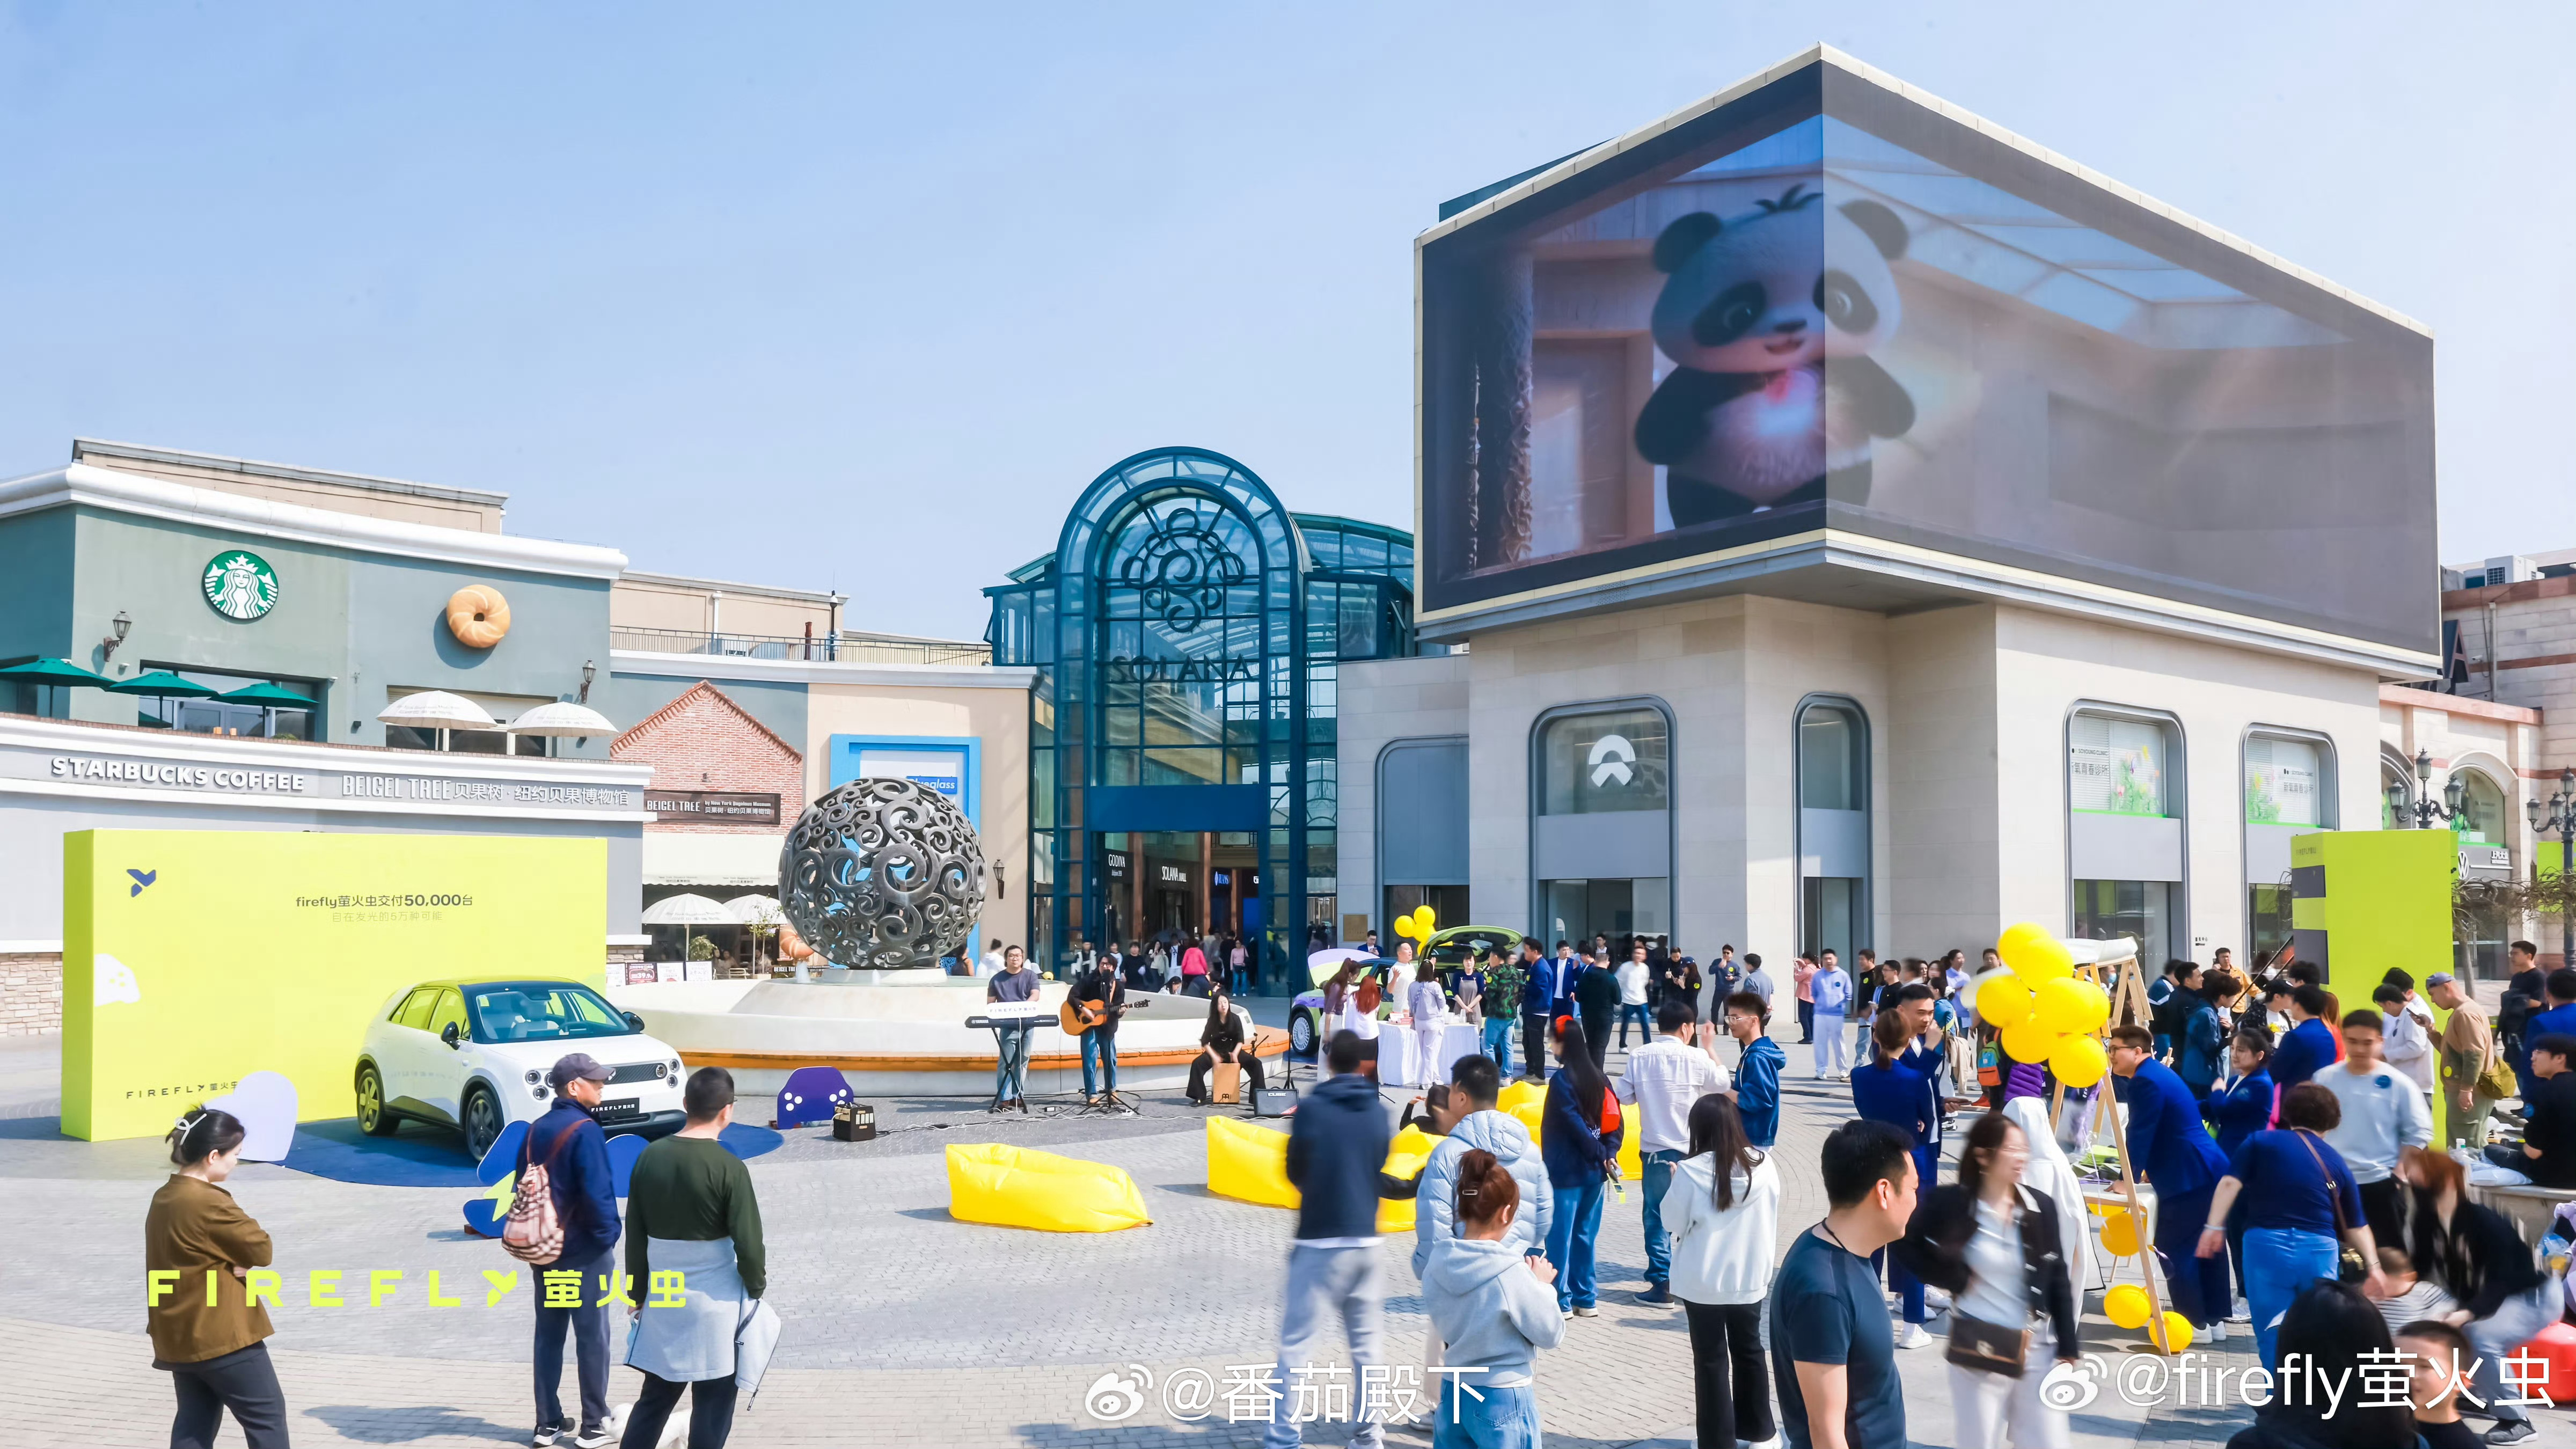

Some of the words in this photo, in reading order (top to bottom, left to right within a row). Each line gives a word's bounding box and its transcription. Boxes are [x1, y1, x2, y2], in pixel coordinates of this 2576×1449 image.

[1110, 653, 1255, 684] SOLANA
[52, 757, 208, 785] STARBUCKS
[214, 770, 304, 791] COFFEE
[342, 774, 402, 799] BEIGEL
[408, 778, 452, 801] TREE
[909, 778, 955, 789] eglass
[647, 800, 676, 811] BEIGEL
[679, 801, 700, 812] TREE
[1108, 854, 1125, 868] GODIVA
[1162, 866, 1179, 881] SOLANA
[126, 1085, 204, 1099] FIREFLY
